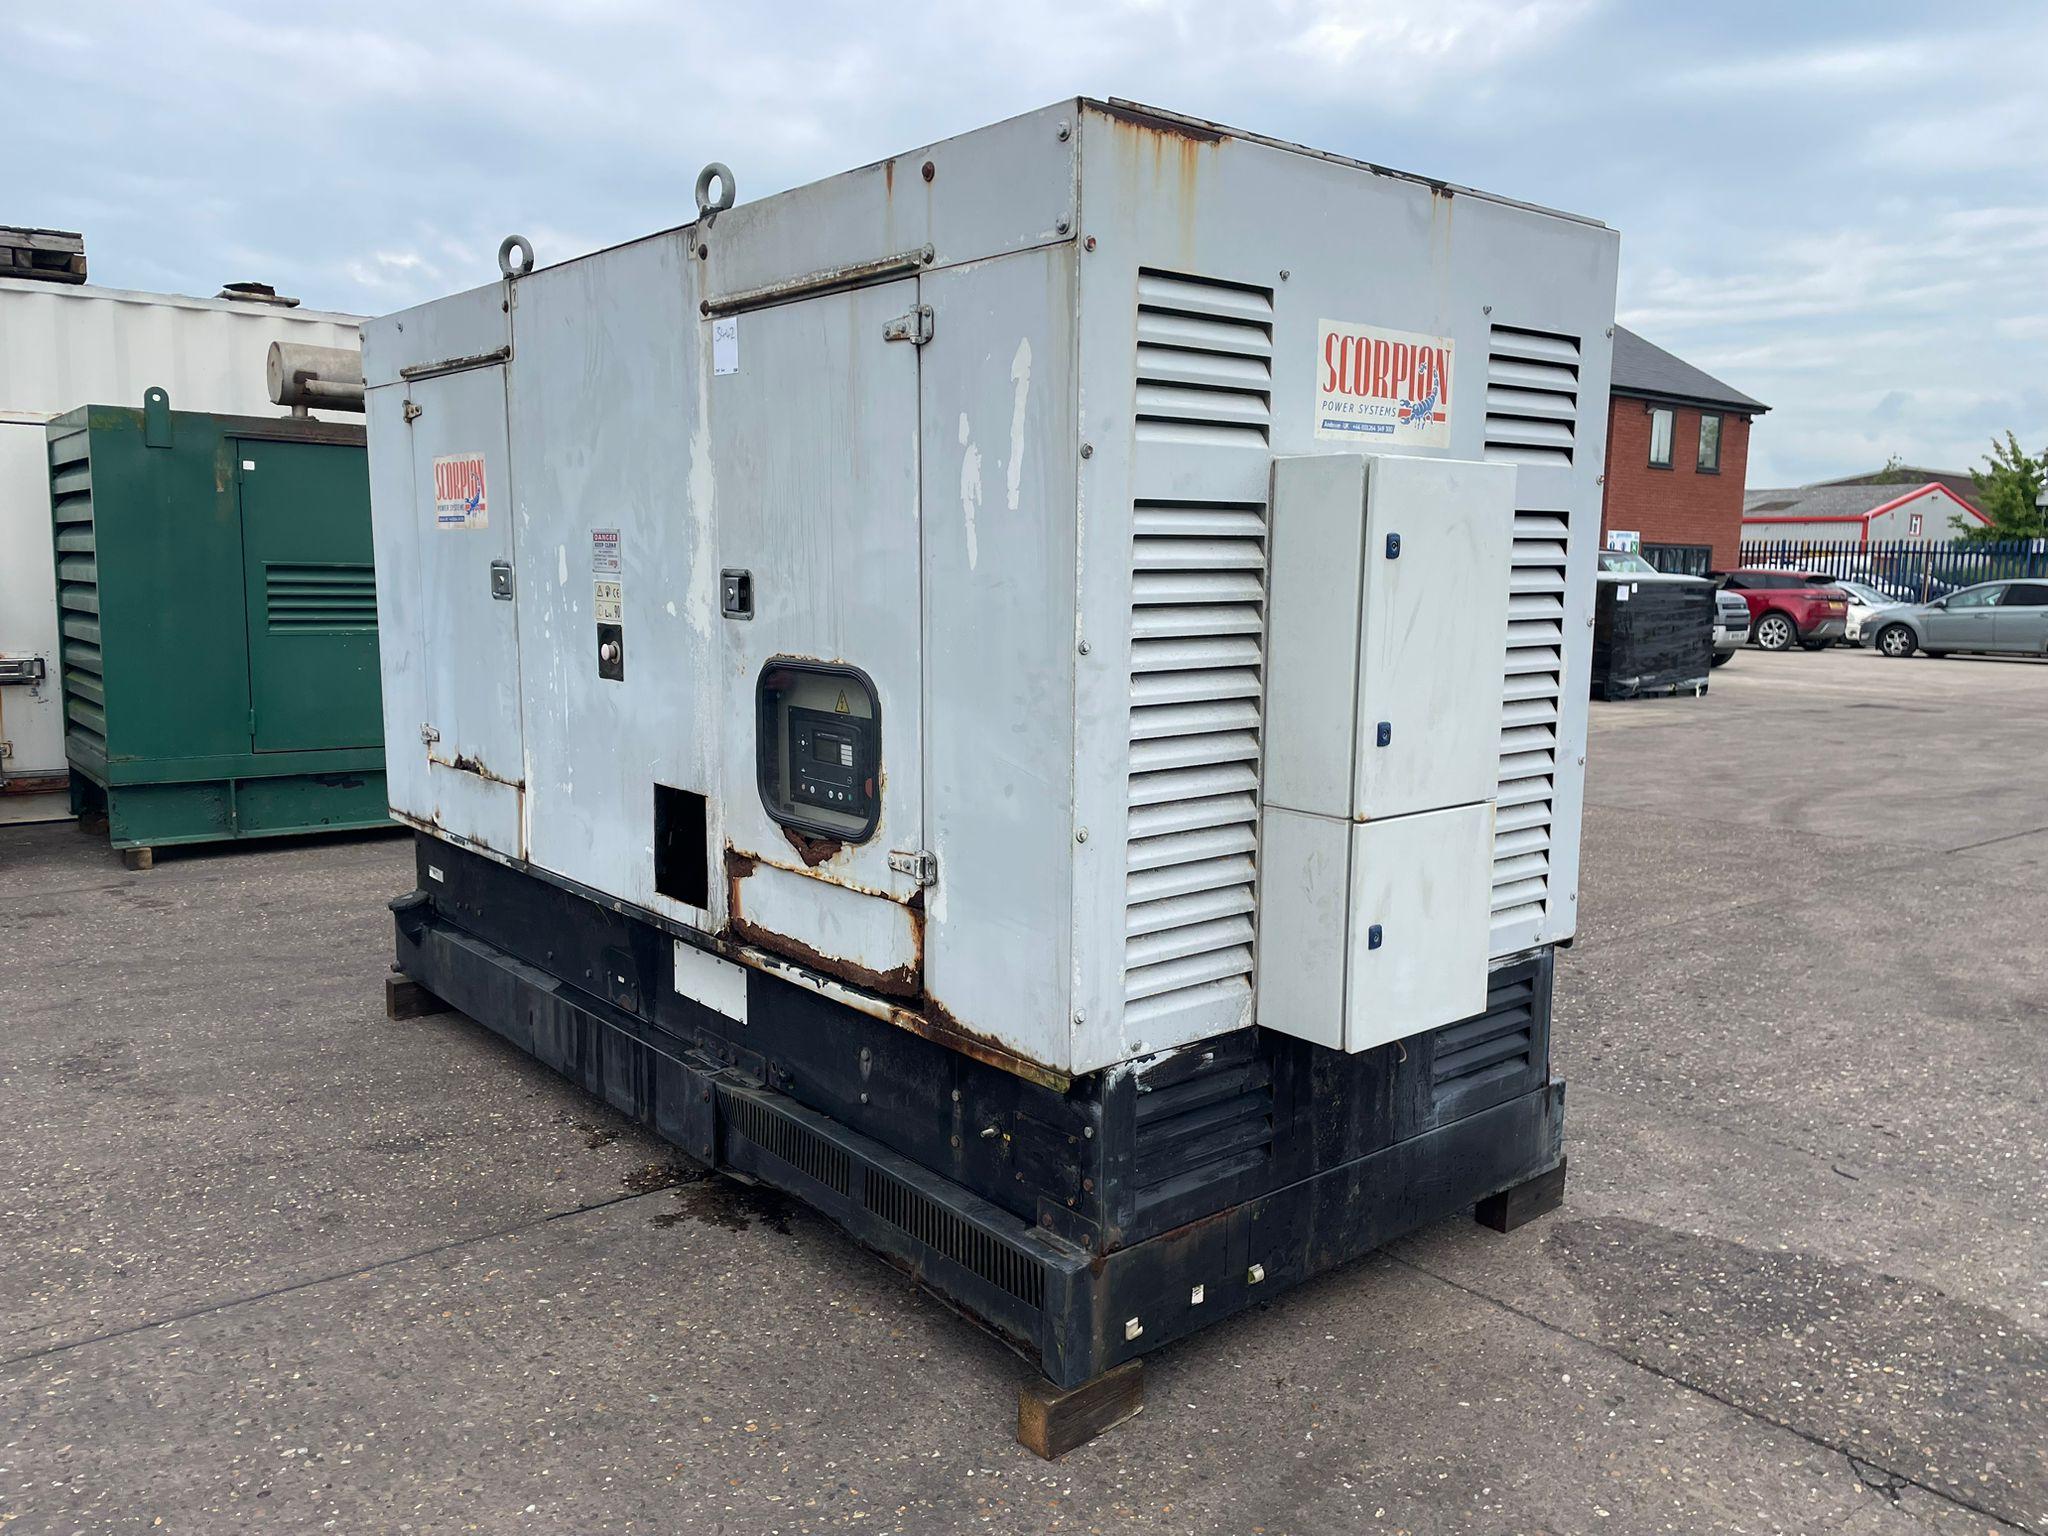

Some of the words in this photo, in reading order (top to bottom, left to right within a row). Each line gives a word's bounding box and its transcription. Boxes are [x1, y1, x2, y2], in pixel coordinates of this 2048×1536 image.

[1322, 332, 1452, 405] SCORPION
[1321, 400, 1354, 412] POWER
[1358, 403, 1397, 418] SYSTEMS
[436, 460, 485, 500] SCORPION
